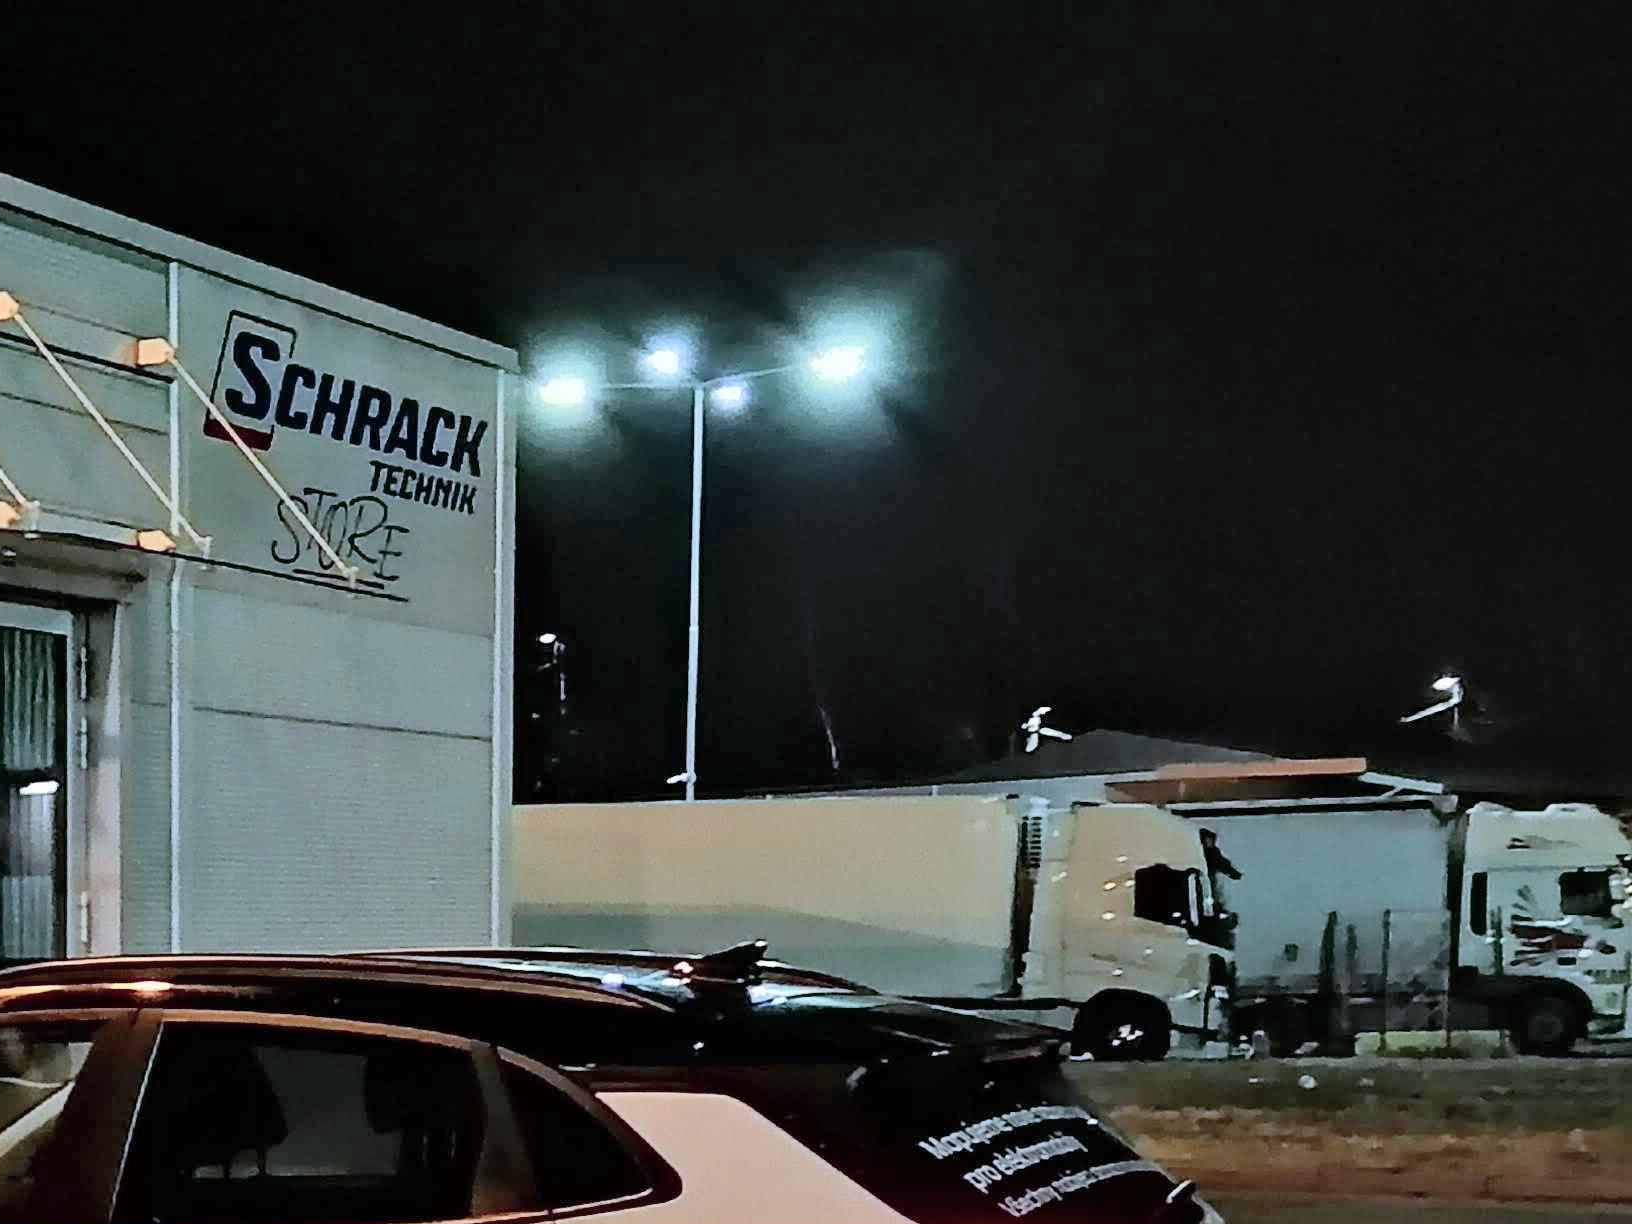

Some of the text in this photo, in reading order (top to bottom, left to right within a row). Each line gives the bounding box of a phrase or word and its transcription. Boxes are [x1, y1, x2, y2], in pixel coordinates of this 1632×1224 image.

[224, 331, 489, 478] SCHRACK
[369, 459, 477, 514] TECHNIK
[271, 487, 411, 581] STORE
